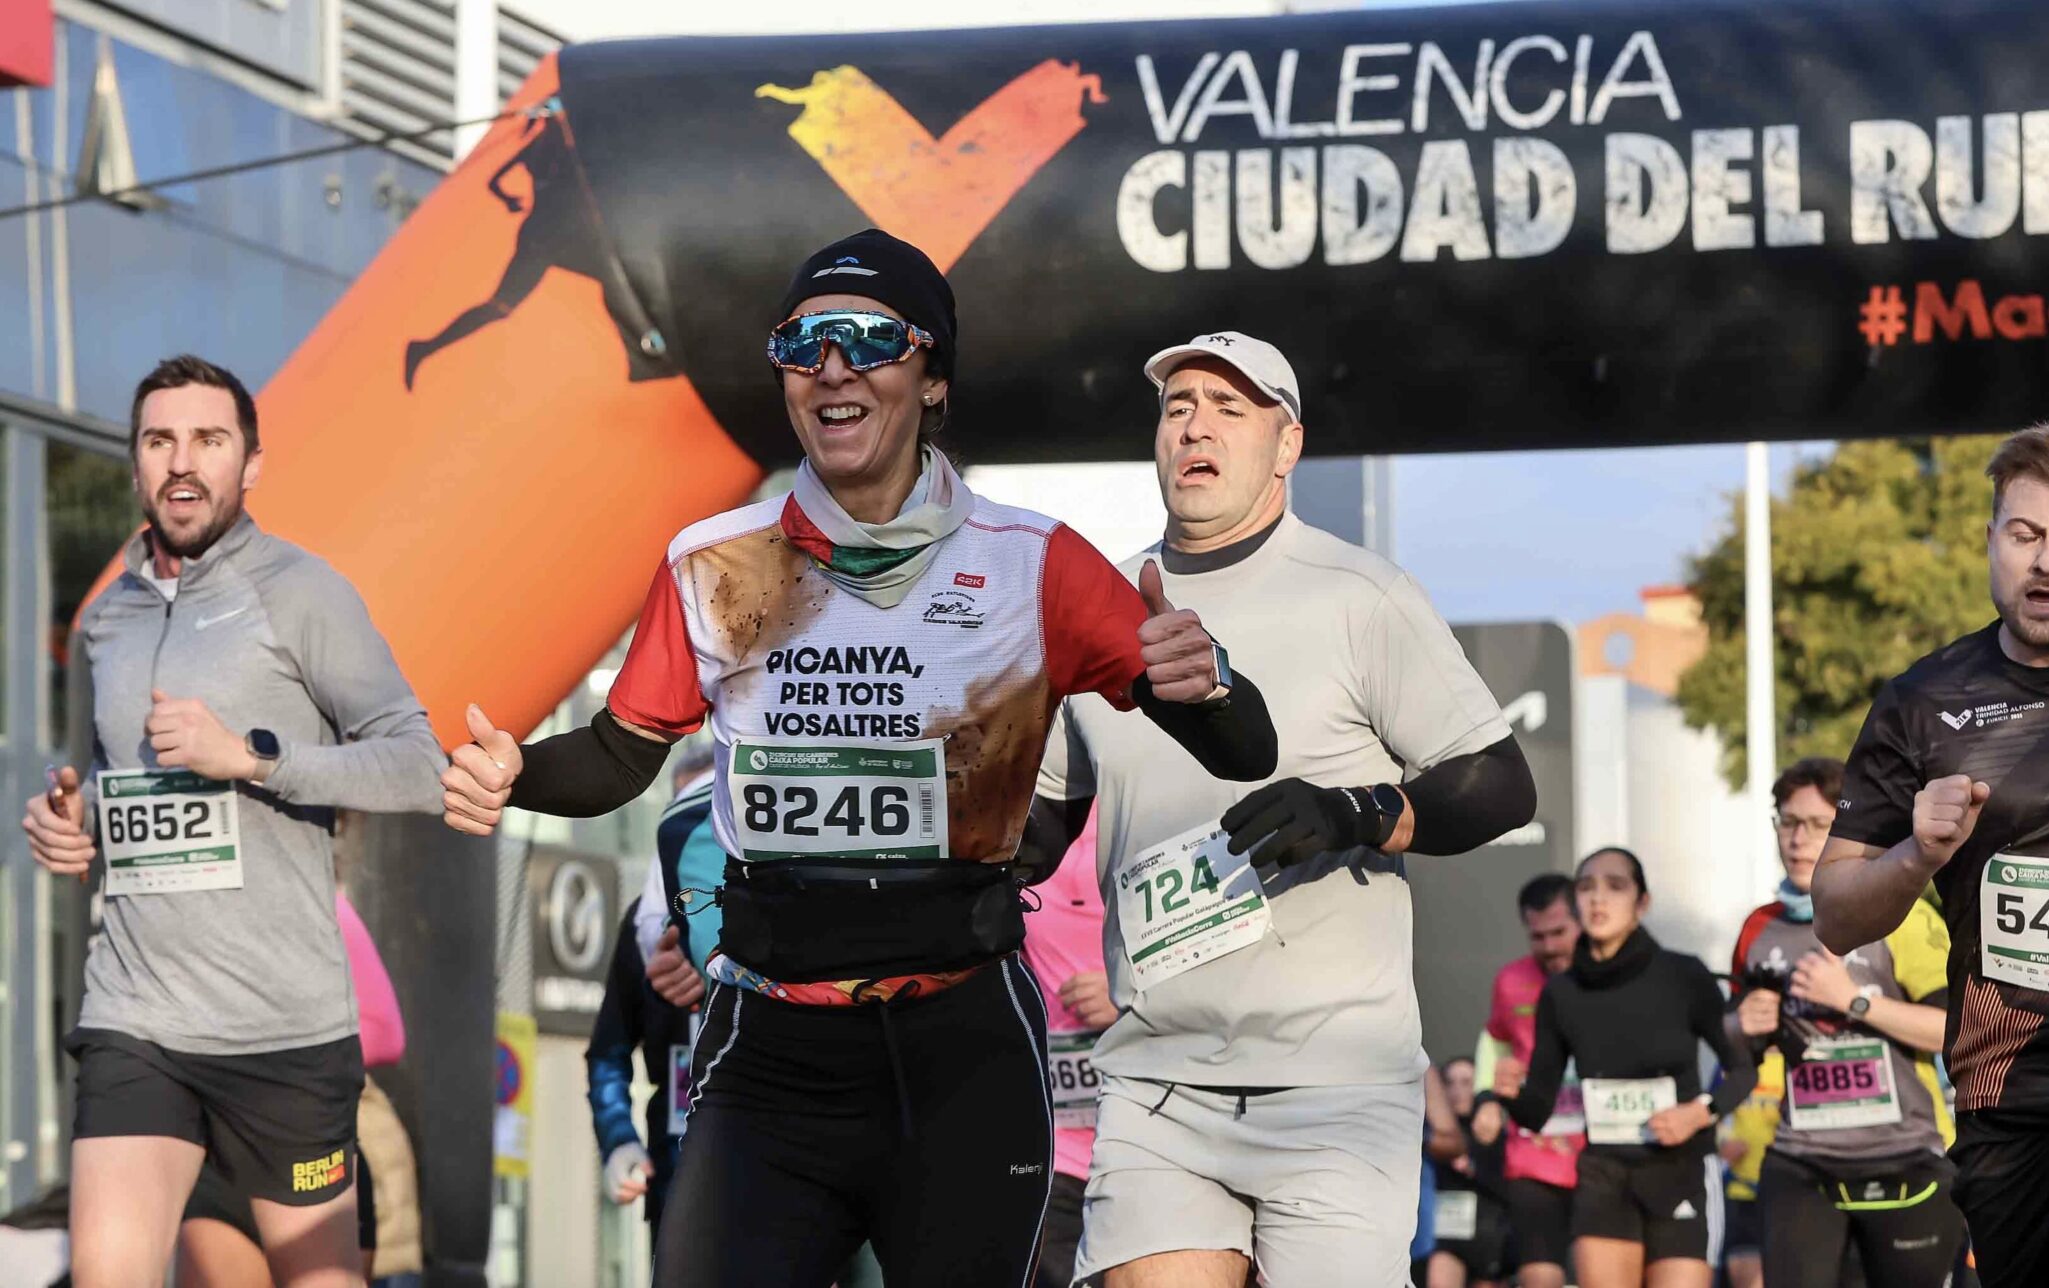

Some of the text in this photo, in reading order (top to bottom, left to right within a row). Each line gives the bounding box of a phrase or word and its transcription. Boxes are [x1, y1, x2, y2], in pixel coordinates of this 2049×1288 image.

[1136, 31, 1682, 144] VALENCIA
[1115, 109, 2049, 273] CIUDAD DEL RU
[765, 646, 924, 678] PICANYA,
[779, 681, 904, 706] PER TOTS
[1975, 702, 2007, 713] VALENCIA
[1976, 701, 2045, 719] TRINIDAD ALFONSO
[764, 713, 921, 738] VOSALTRES
[108, 801, 212, 844] 6652
[743, 784, 910, 836] 8246
[1134, 854, 1220, 923] 724
[1794, 1063, 1874, 1092] 4885
[294, 1170, 328, 1192] RUN
